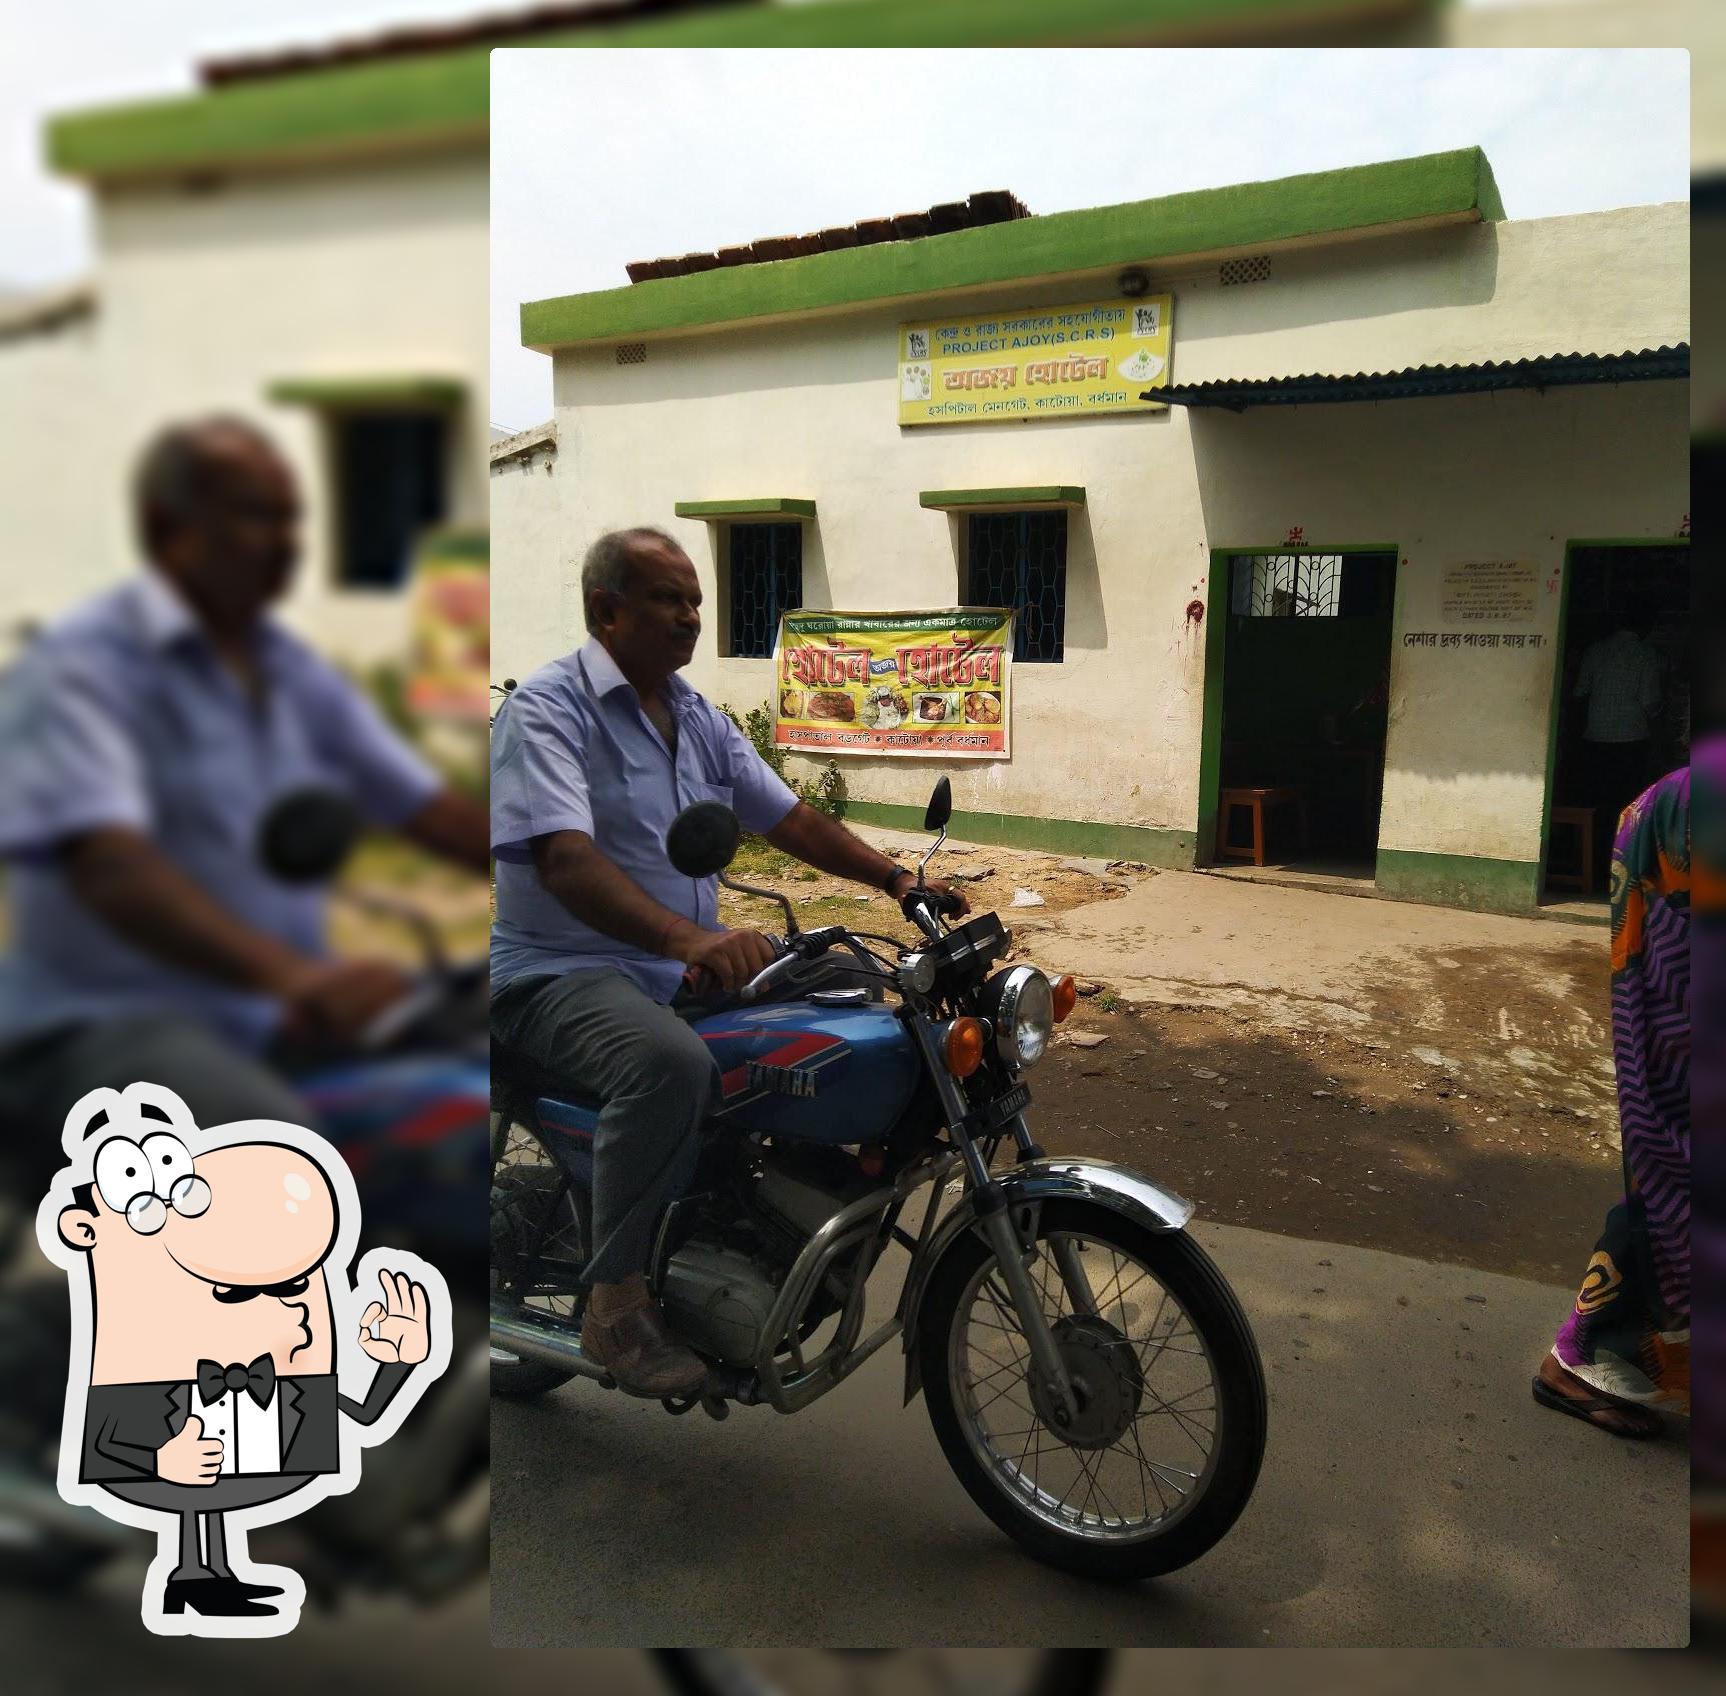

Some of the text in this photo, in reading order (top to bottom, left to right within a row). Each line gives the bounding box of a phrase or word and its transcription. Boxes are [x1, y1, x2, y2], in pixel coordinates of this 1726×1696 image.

[962, 326, 971, 336] ও
[1002, 317, 1053, 334] সরকারের
[942, 337, 1007, 355] PROJECT
[943, 353, 1108, 391] অজয় হোটেল
[928, 399, 977, 416] হসপিটাল
[837, 619, 861, 630] রান্নার
[923, 617, 957, 628] একমাত্র
[960, 615, 998, 628] হোটেল
[1403, 632, 1438, 649] নেশার
[1440, 633, 1463, 650] দ্রব্য
[1462, 633, 1500, 649] পাওয়া
[1502, 633, 1525, 649] যায়
[782, 636, 872, 688] হোটেল
[896, 633, 1004, 688] হোটেল
